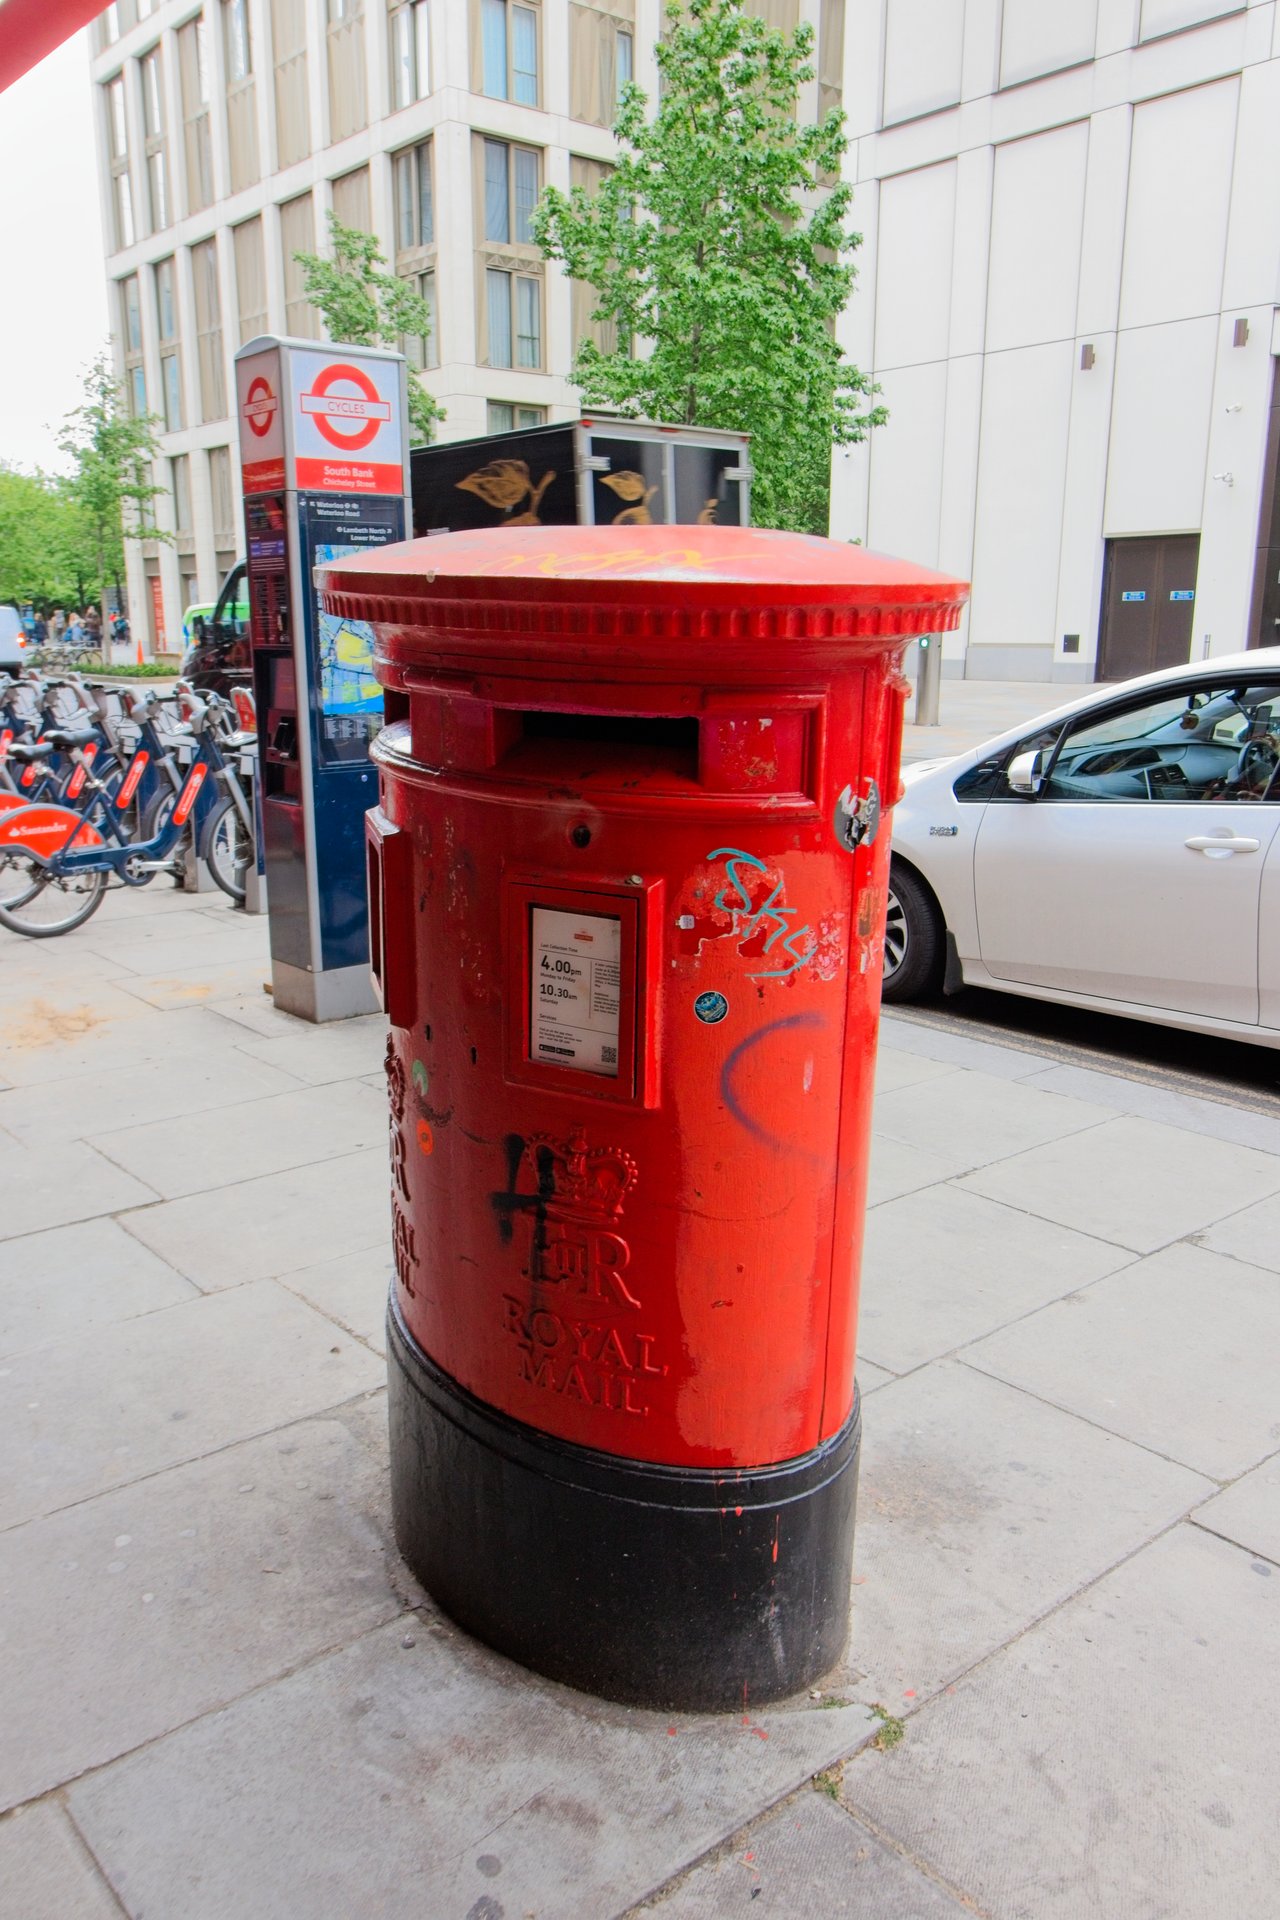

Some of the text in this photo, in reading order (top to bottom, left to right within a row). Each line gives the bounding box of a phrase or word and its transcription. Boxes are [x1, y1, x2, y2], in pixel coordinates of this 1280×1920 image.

[328, 400, 366, 415] CYCLES
[323, 465, 375, 479] South Bank
[316, 501, 344, 510] Waterloo
[316, 509, 360, 518] Waterloo Road
[343, 526, 387, 535] Lambeth North
[350, 534, 368, 542] Lower
[20, 821, 67, 836] Santander
[540, 955, 582, 976] 4.00pm
[540, 983, 578, 1000] 10.30am
[502, 1291, 669, 1377] ROYAL
[517, 1342, 649, 1417] MAIL
